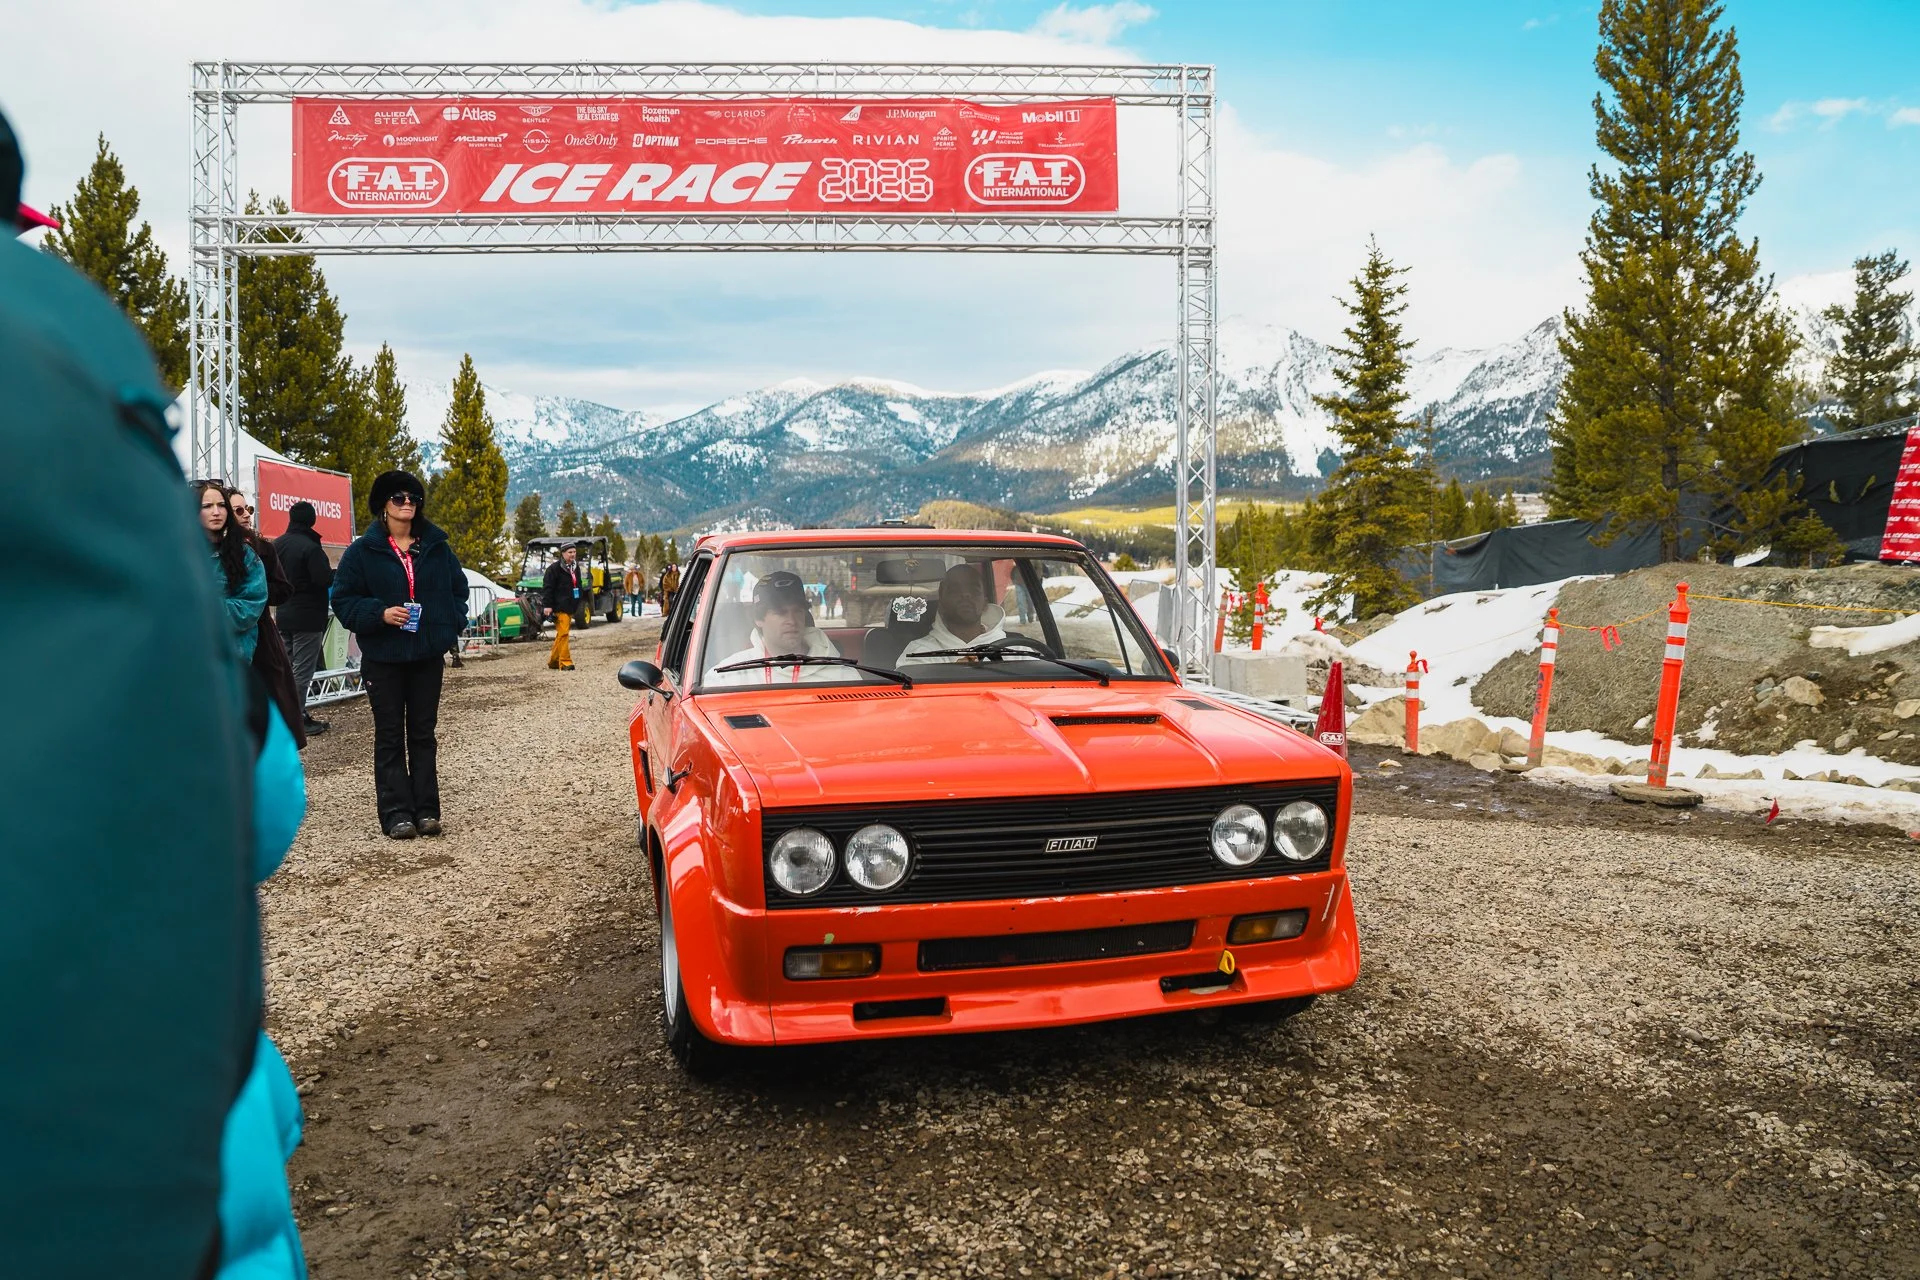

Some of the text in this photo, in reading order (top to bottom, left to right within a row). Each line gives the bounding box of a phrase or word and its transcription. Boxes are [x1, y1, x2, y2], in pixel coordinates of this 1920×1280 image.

[461, 106, 497, 121] Atlas
[642, 106, 680, 115] Bozeman
[724, 109, 766, 118] CLARIOS
[375, 117, 416, 125] STEEL
[577, 113, 591, 121] REAL
[592, 113, 611, 121] ESTATE
[642, 114, 671, 123] Health
[1022, 110, 1064, 123] Mobil
[396, 135, 439, 143] MOONLIGHT
[453, 133, 504, 143] McLaren
[645, 135, 680, 147] OPTIMA
[695, 137, 768, 145] PORSCHE
[852, 134, 920, 146] RIVIAN
[479, 161, 813, 203] ICE RACE
[817, 157, 934, 203] 2026
[346, 191, 433, 201] INTERNATIONAL
[983, 187, 1070, 198] INTERNATIONAL
[1047, 838, 1096, 851] FIAT
